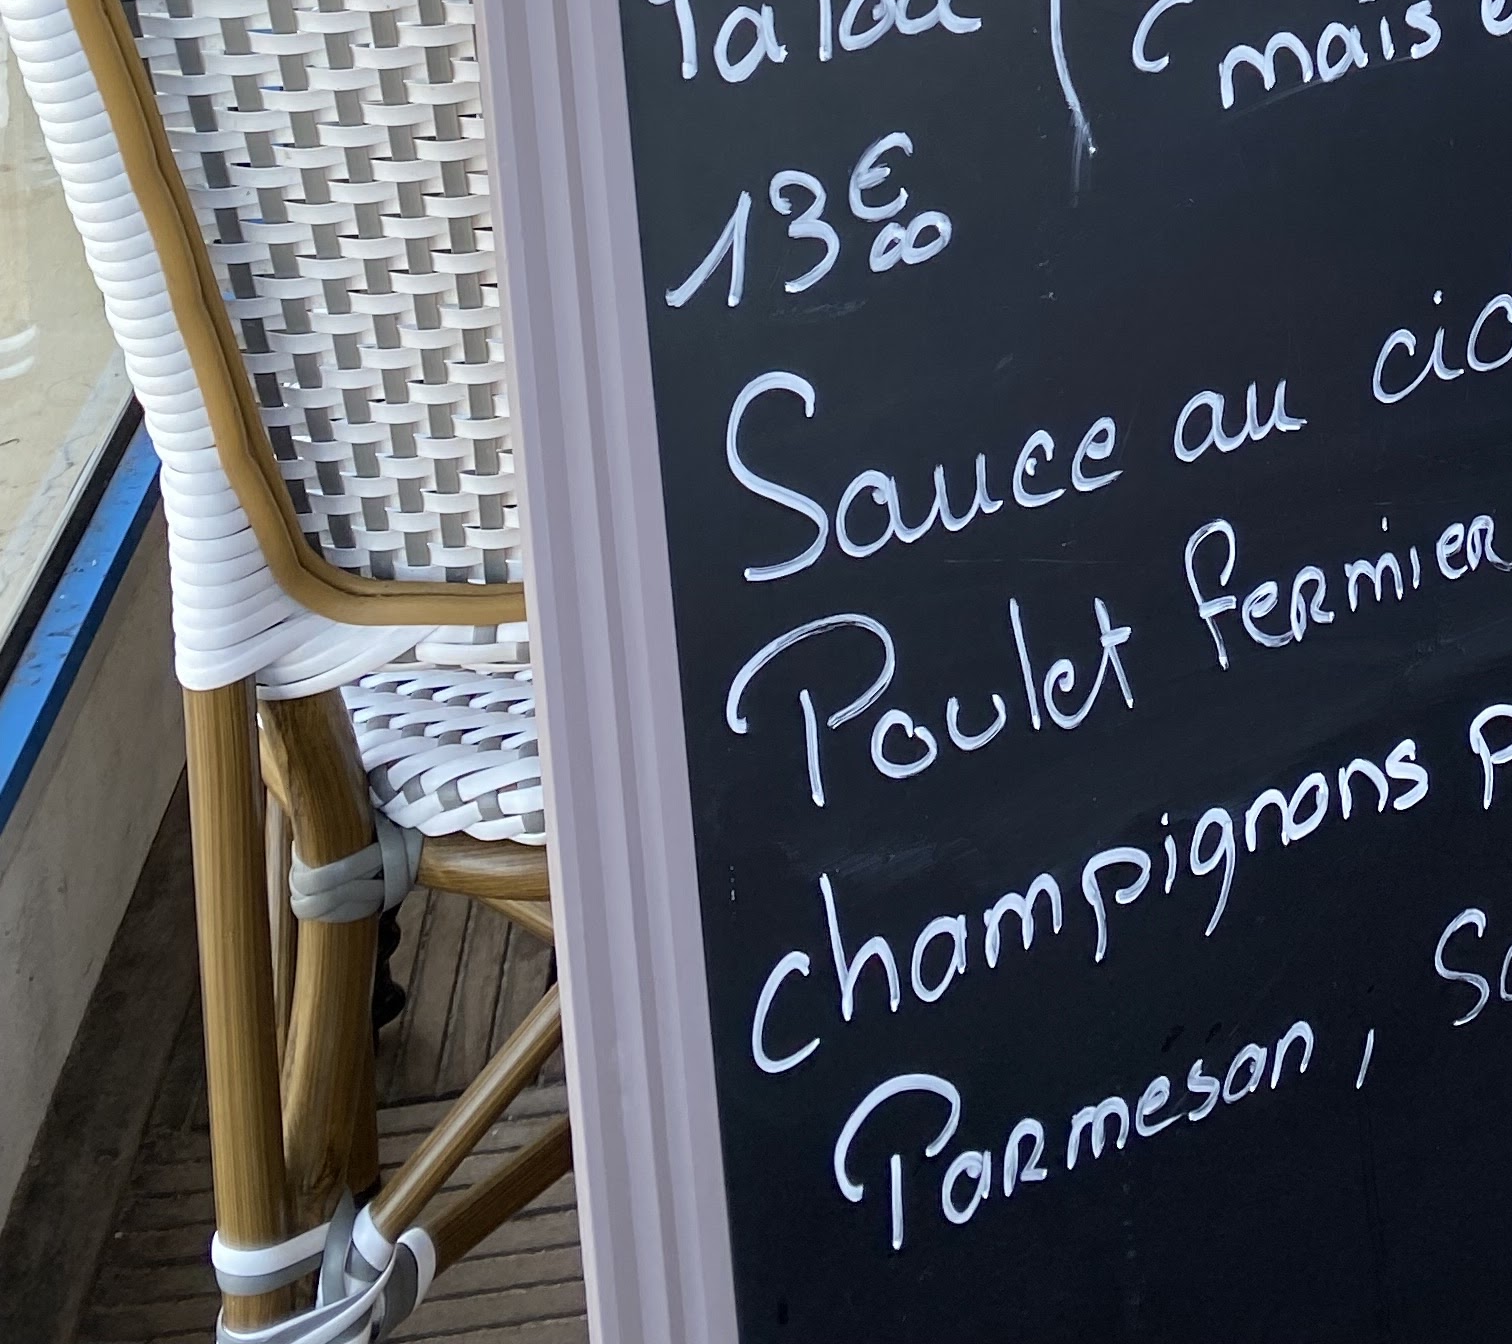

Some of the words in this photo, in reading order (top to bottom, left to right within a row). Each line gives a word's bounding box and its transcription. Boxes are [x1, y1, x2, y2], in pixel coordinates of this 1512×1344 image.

[726, 370, 1124, 582] Sauce
[1173, 378, 1308, 463] au
[726, 597, 1135, 807] Poulet
